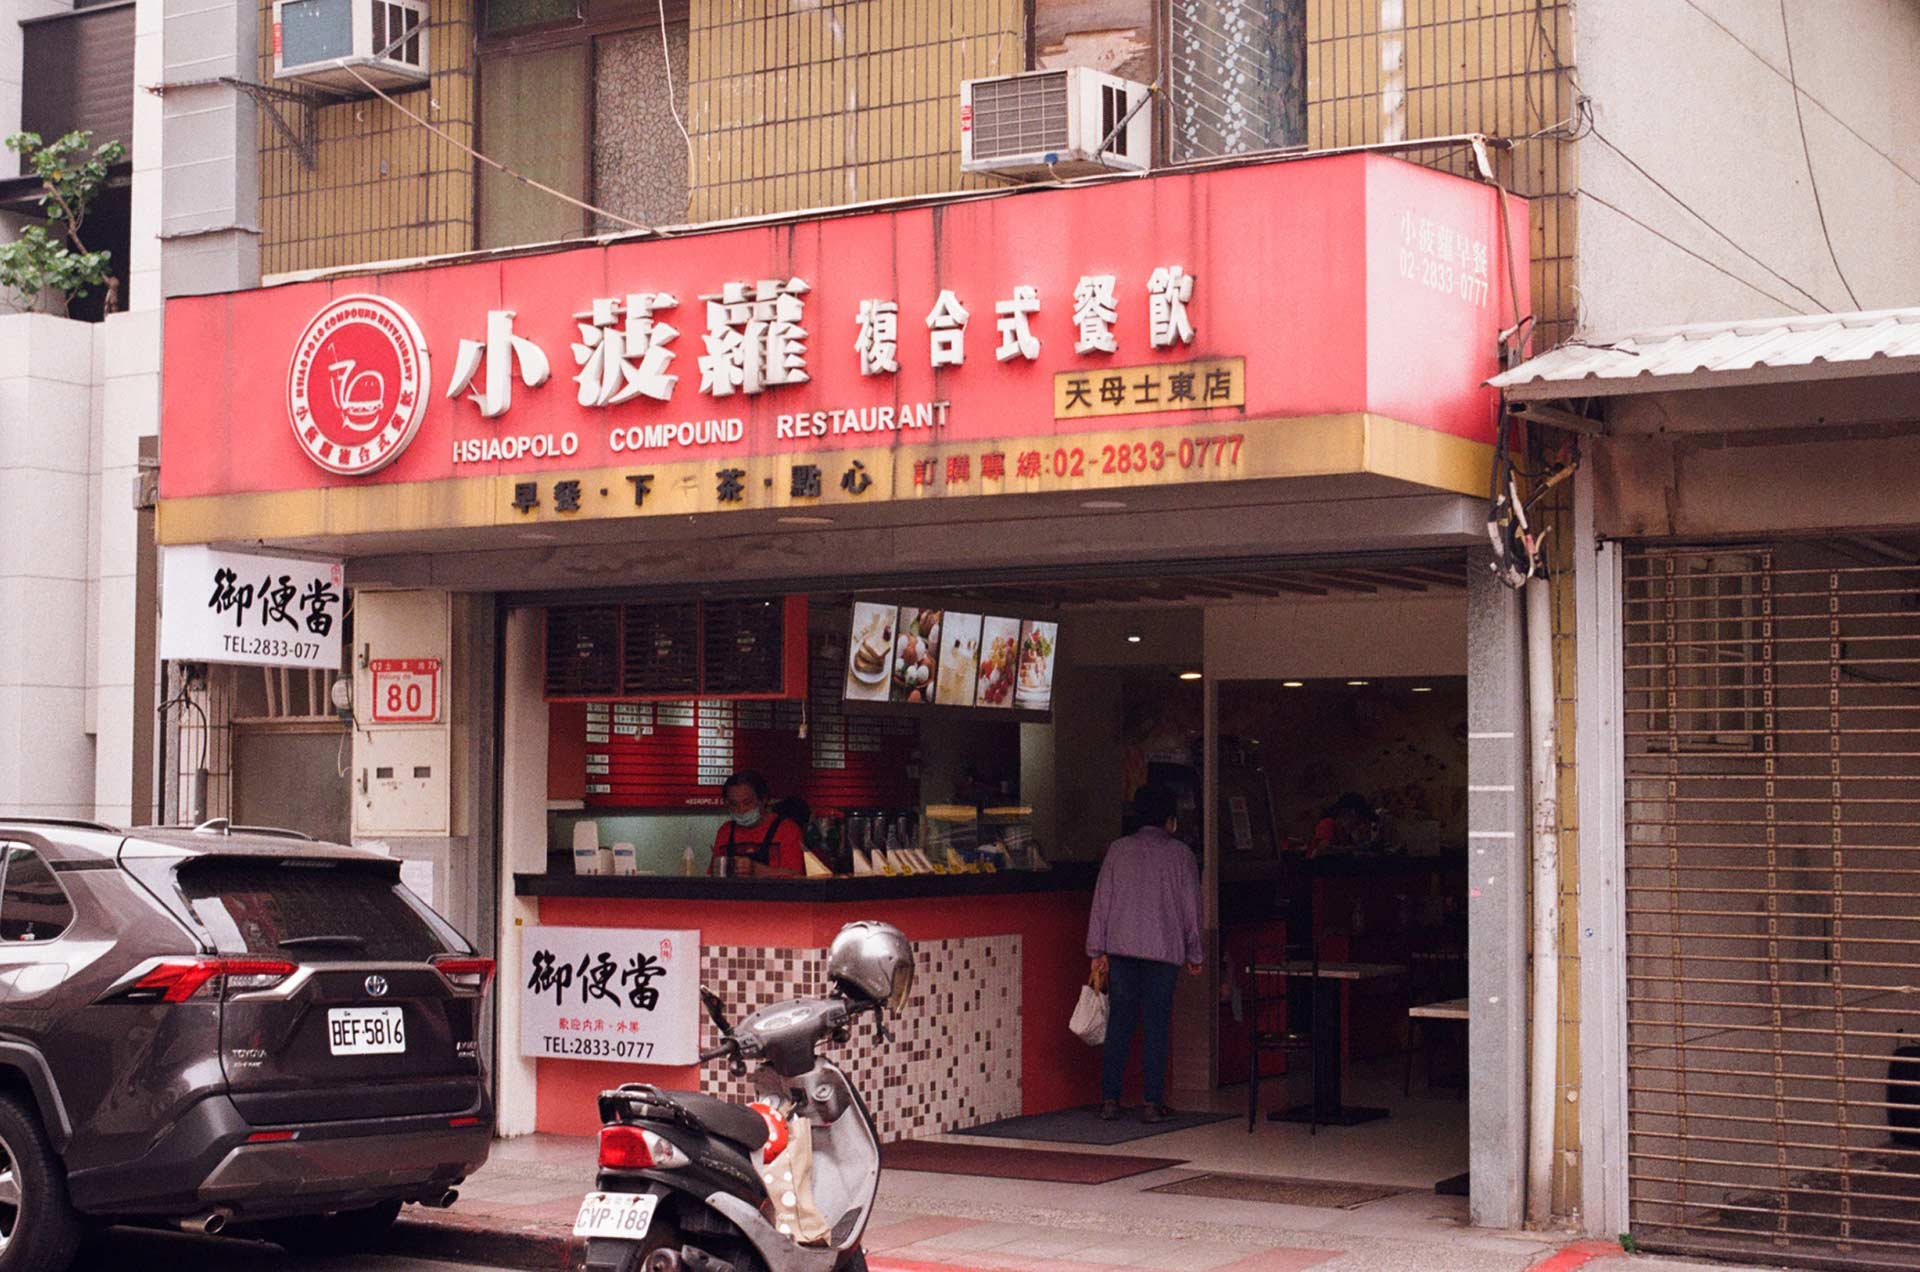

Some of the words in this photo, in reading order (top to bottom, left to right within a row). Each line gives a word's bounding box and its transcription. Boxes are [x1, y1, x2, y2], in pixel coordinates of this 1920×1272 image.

[1400, 247, 1489, 308] 02-2833-0777
[324, 308, 379, 330] COMPOUND
[377, 314, 413, 382] RESTAURANT
[446, 277, 811, 418] 小菠蘿
[853, 265, 1197, 376] 複合式餐飲
[1065, 369, 1231, 410] 天母士東店
[453, 432, 578, 463] HSIAOPOLO
[610, 419, 743, 451] COMPOUND
[777, 401, 950, 439] RESTAURANT
[208, 568, 340, 638] 御便當
[224, 635, 320, 660] TEL:2833-077
[387, 684, 421, 713] 80
[528, 949, 666, 1012] 御便當
[544, 1036, 655, 1059] TEL:2833-0777
